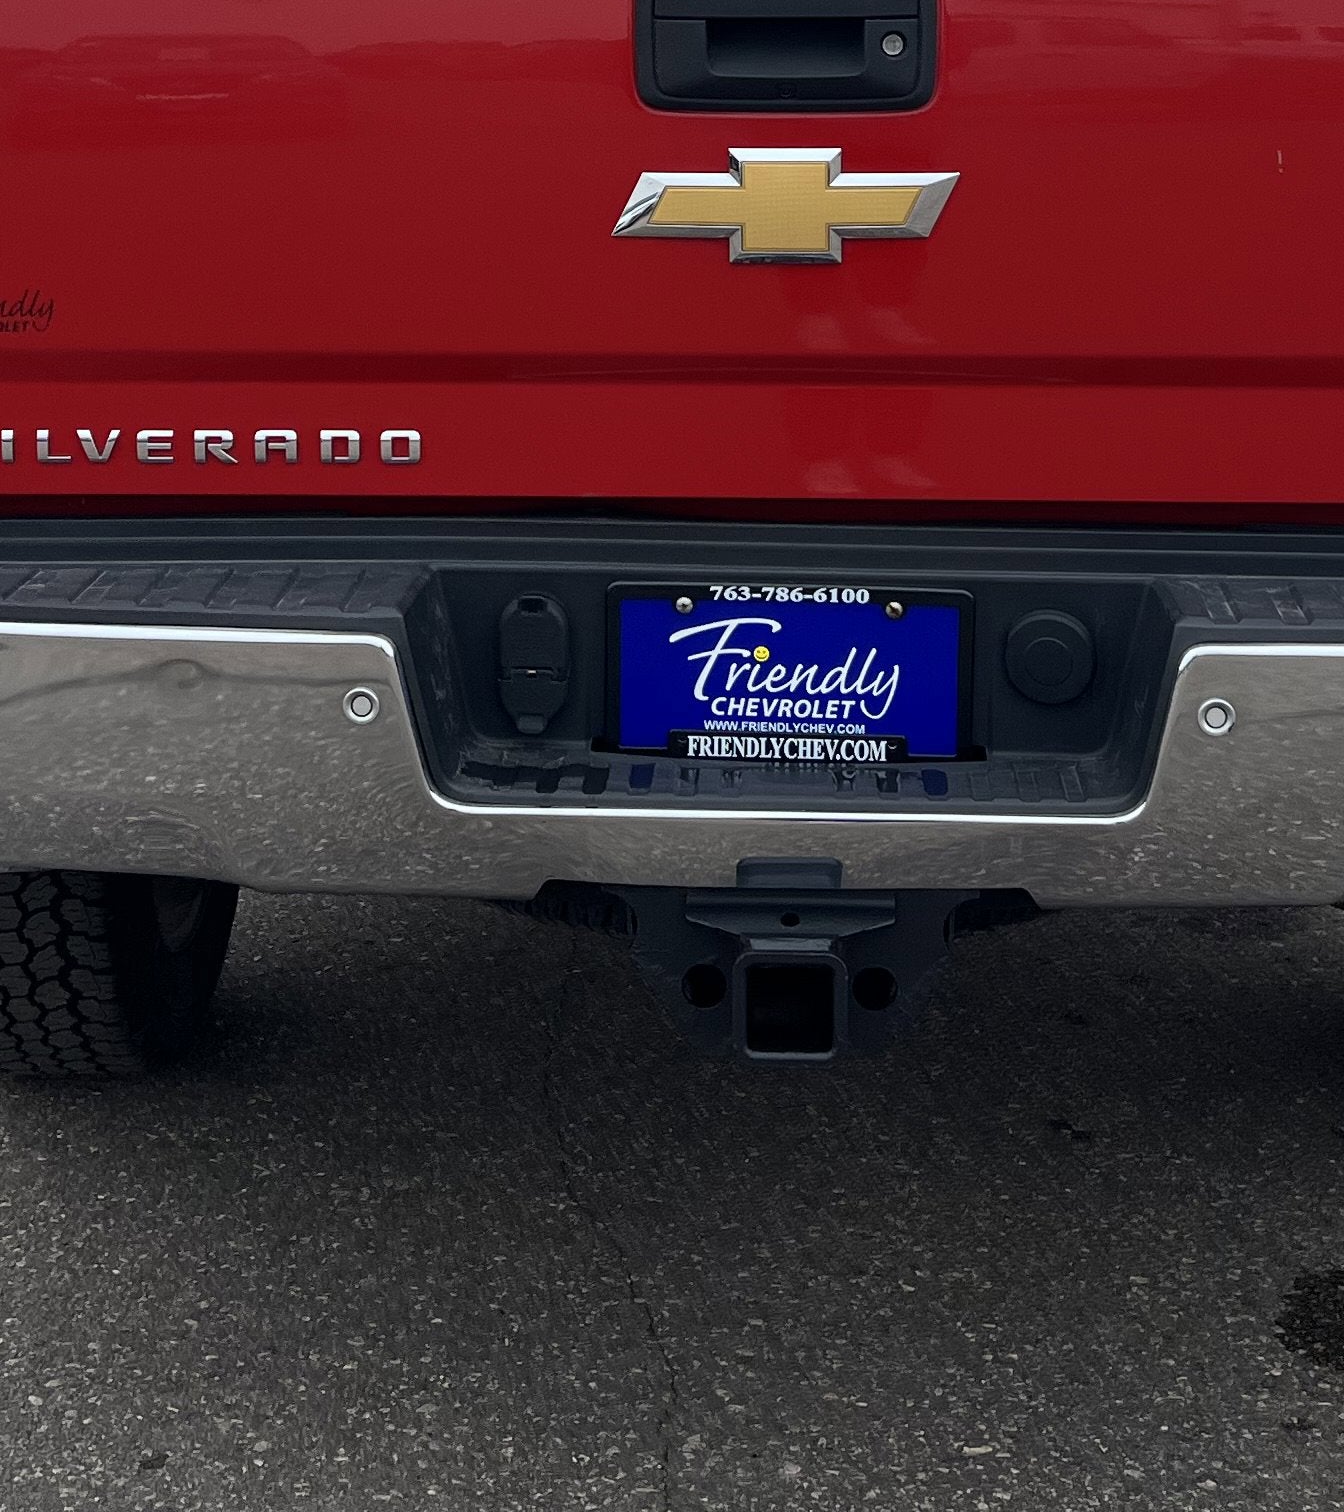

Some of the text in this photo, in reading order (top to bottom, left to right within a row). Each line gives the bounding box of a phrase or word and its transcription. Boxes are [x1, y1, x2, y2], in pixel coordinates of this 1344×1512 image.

[709, 586, 870, 604] 763-786-6100
[669, 617, 901, 719] Friendly
[711, 697, 856, 719] CHEVROLET
[704, 719, 866, 735] WWW.FRIENDLYCHEV.COM
[687, 735, 887, 762] FRIENDLYCHEV.COM
